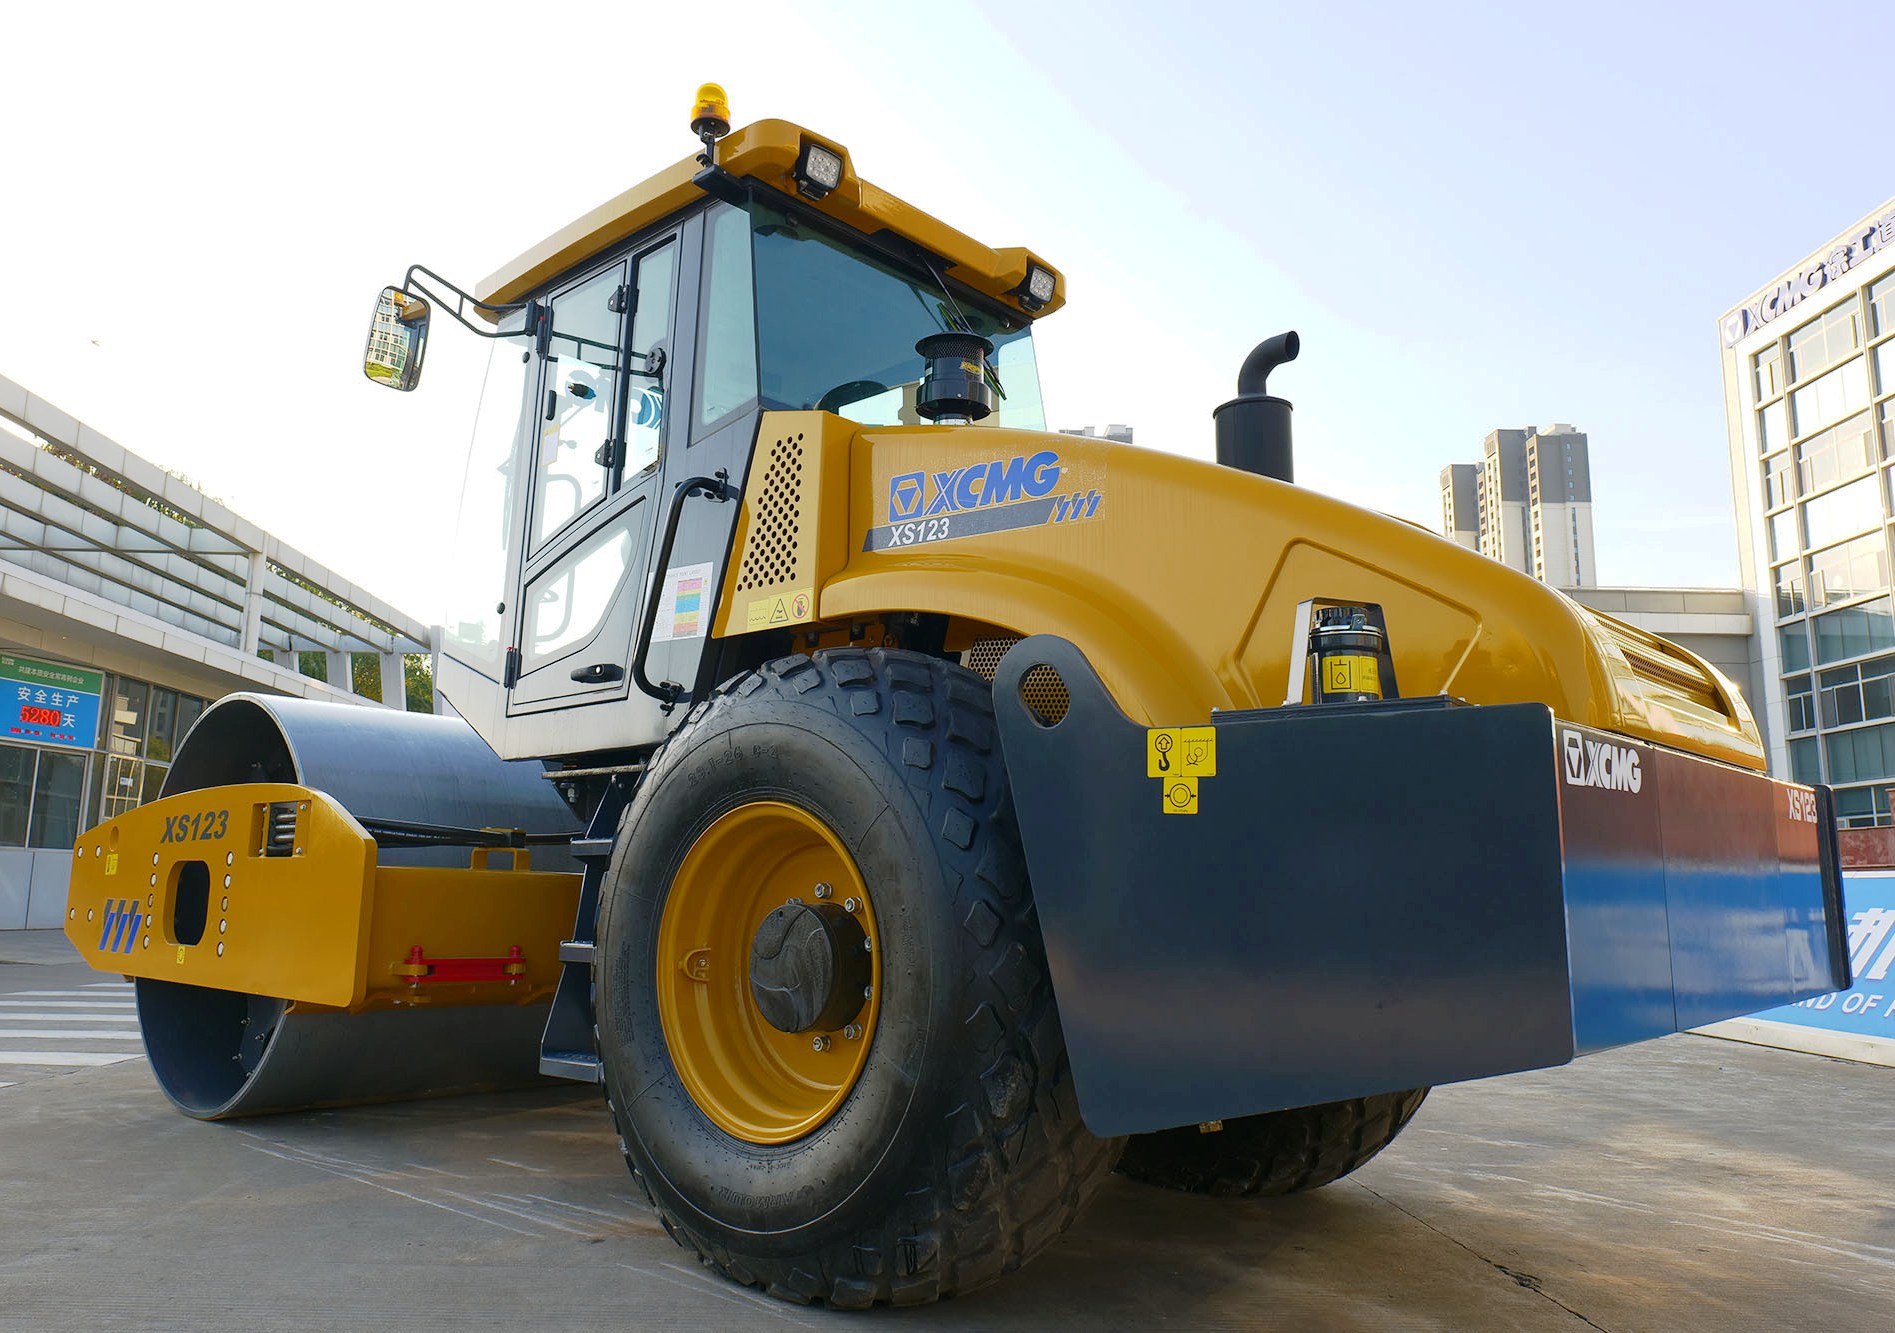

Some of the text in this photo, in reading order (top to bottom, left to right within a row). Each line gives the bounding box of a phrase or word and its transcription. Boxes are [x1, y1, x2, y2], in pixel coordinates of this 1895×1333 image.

[1744, 262, 1828, 336] XCMG
[923, 451, 1061, 516] XCMG
[888, 518, 950, 547] XS123
[17, 686, 79, 708] 安全生产
[20, 706, 76, 728] 5280 天
[1585, 739, 1642, 794] XCMG
[1786, 787, 1818, 824] XS123
[160, 810, 230, 844] XS123
[1841, 991, 1884, 1015] OF
